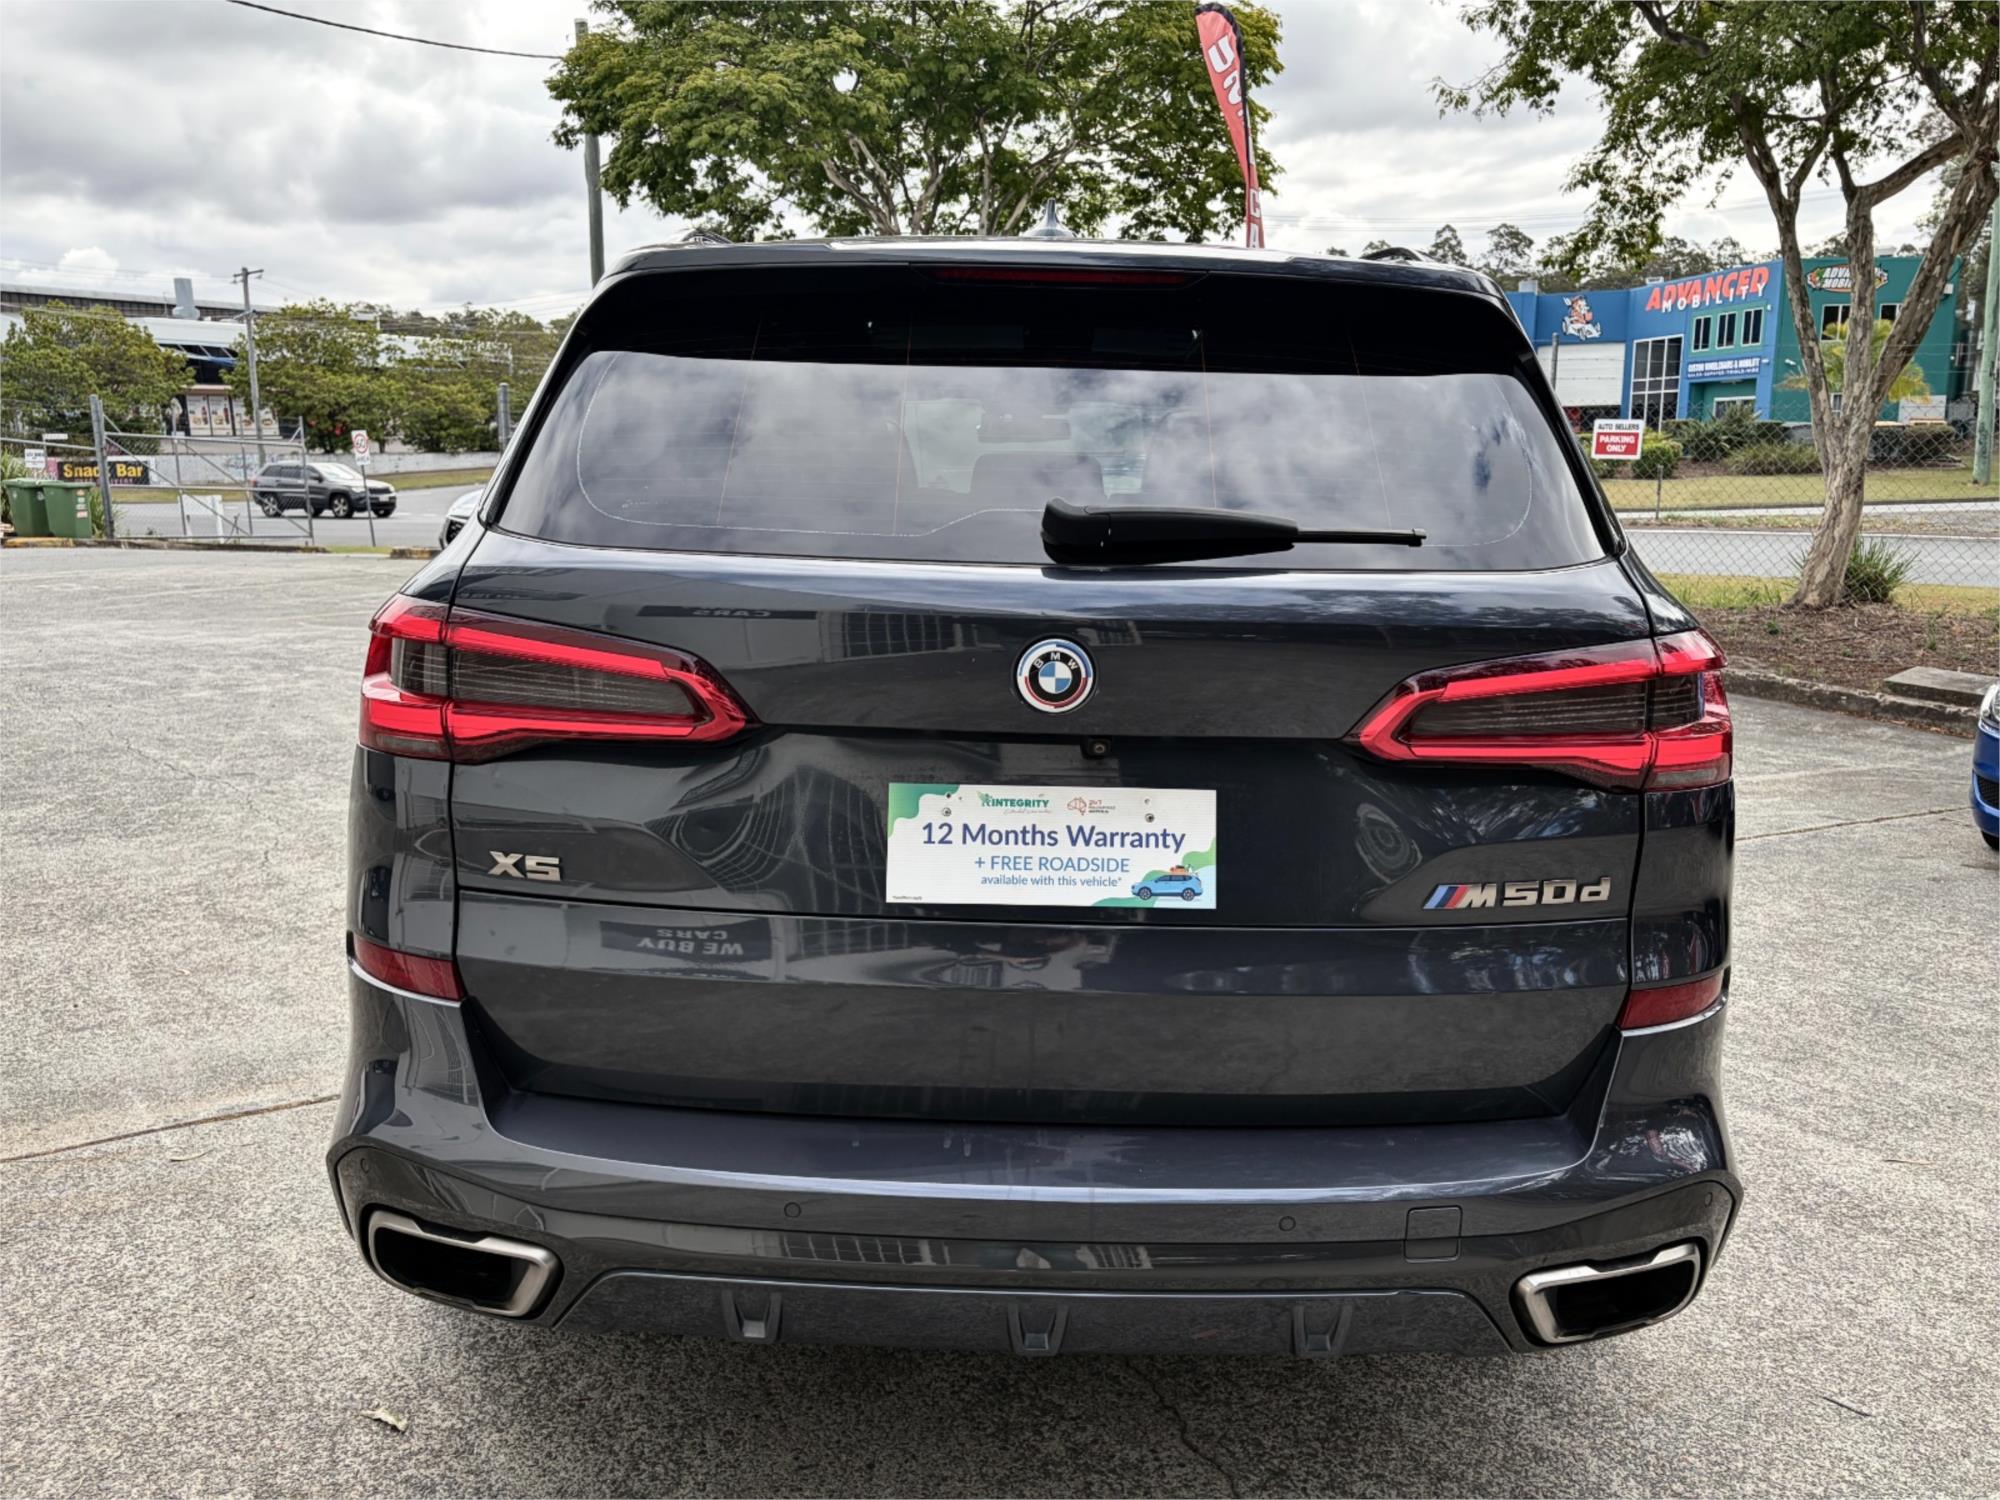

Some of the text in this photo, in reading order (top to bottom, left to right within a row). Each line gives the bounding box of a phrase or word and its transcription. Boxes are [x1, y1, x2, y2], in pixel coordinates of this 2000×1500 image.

[1823, 267, 1850, 278] ADVA
[1645, 267, 1769, 311] ADVANCED
[1822, 279, 1851, 288] MOBI
[1661, 283, 1766, 313] MOBILITY
[1600, 435, 1635, 444] PARKING
[1606, 444, 1627, 452] ONLY
[63, 463, 143, 478] Snac Bar
[1033, 652, 1078, 670] BMW
[991, 798, 1050, 808] INTEGRITY
[921, 822, 1187, 853] 12 Months Warranty
[488, 851, 561, 881] X5
[991, 855, 1033, 871] FREE
[1038, 857, 1130, 873] ROADSIDE
[980, 874, 1029, 887] available
[1030, 874, 1055, 887] with
[1057, 875, 1078, 888] this
[656, 928, 729, 940] CARS
[636, 937, 744, 956] WE BUY
